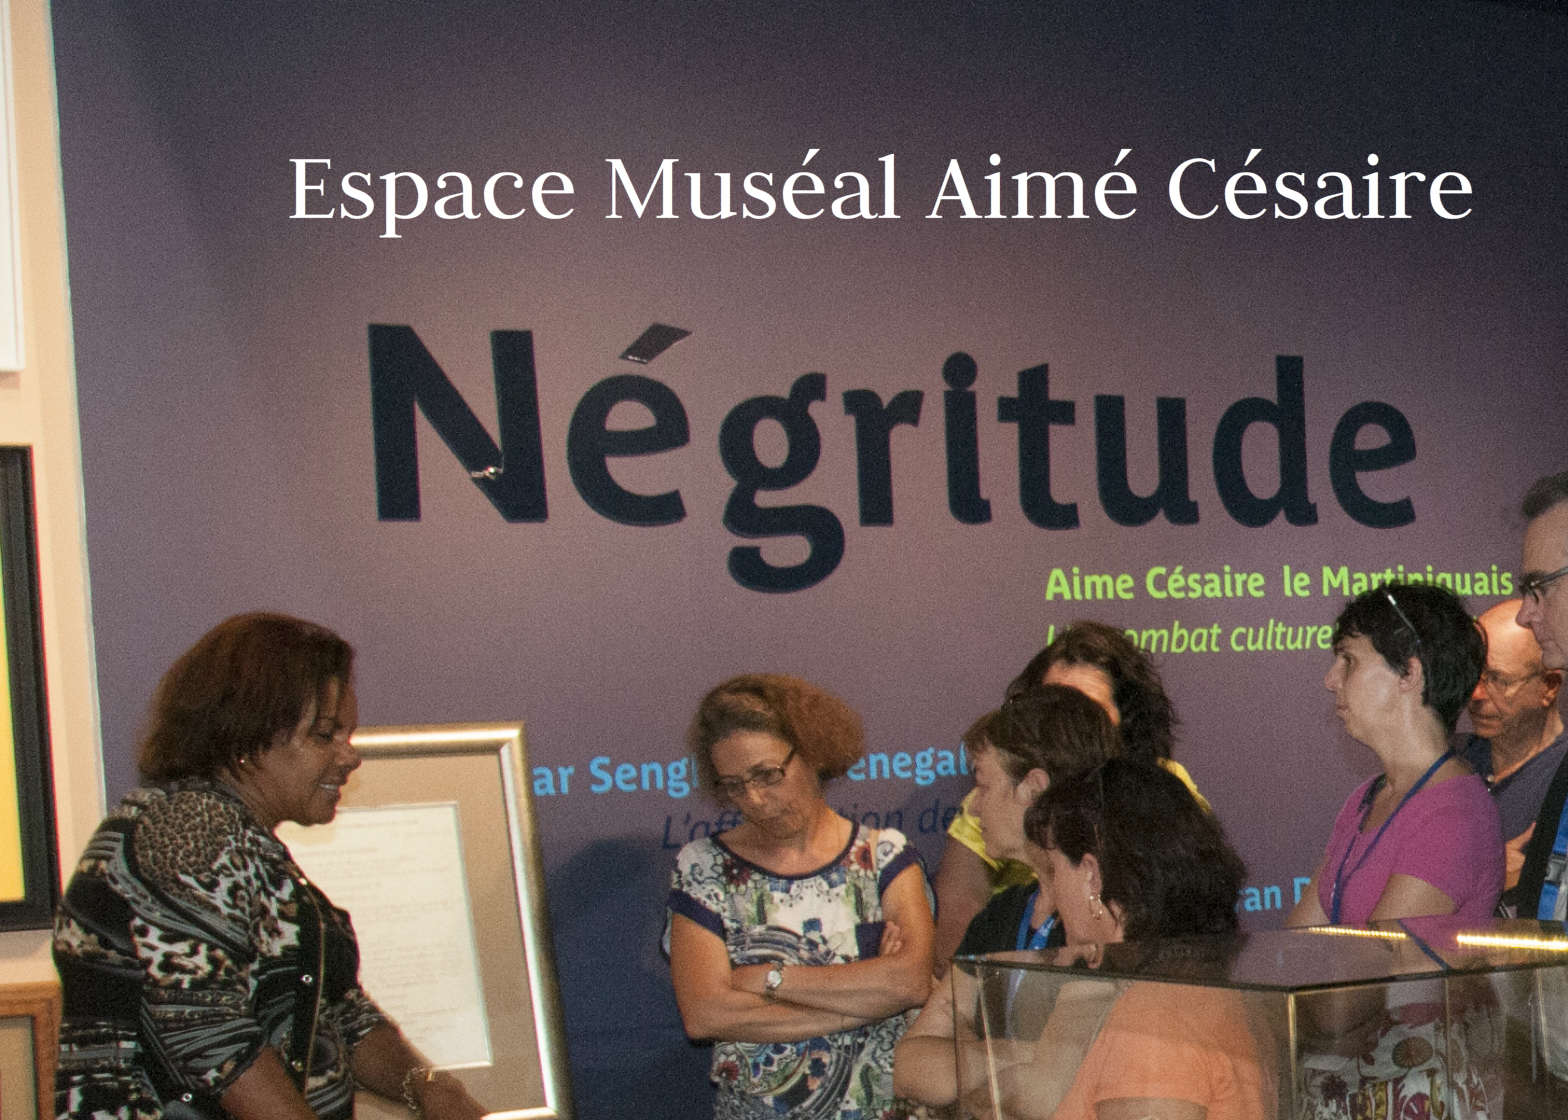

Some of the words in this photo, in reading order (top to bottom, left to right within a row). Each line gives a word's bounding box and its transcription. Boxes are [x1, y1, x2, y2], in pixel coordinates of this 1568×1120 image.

[367, 322, 1418, 595] Négritude
[1045, 566, 1135, 601] Aime
[1145, 564, 1266, 599] Césaire
[1282, 564, 1312, 598] le
[1124, 620, 1223, 654] ombat
[532, 764, 576, 797] ar
[588, 755, 698, 799] Seng
[846, 744, 971, 786] enegal
